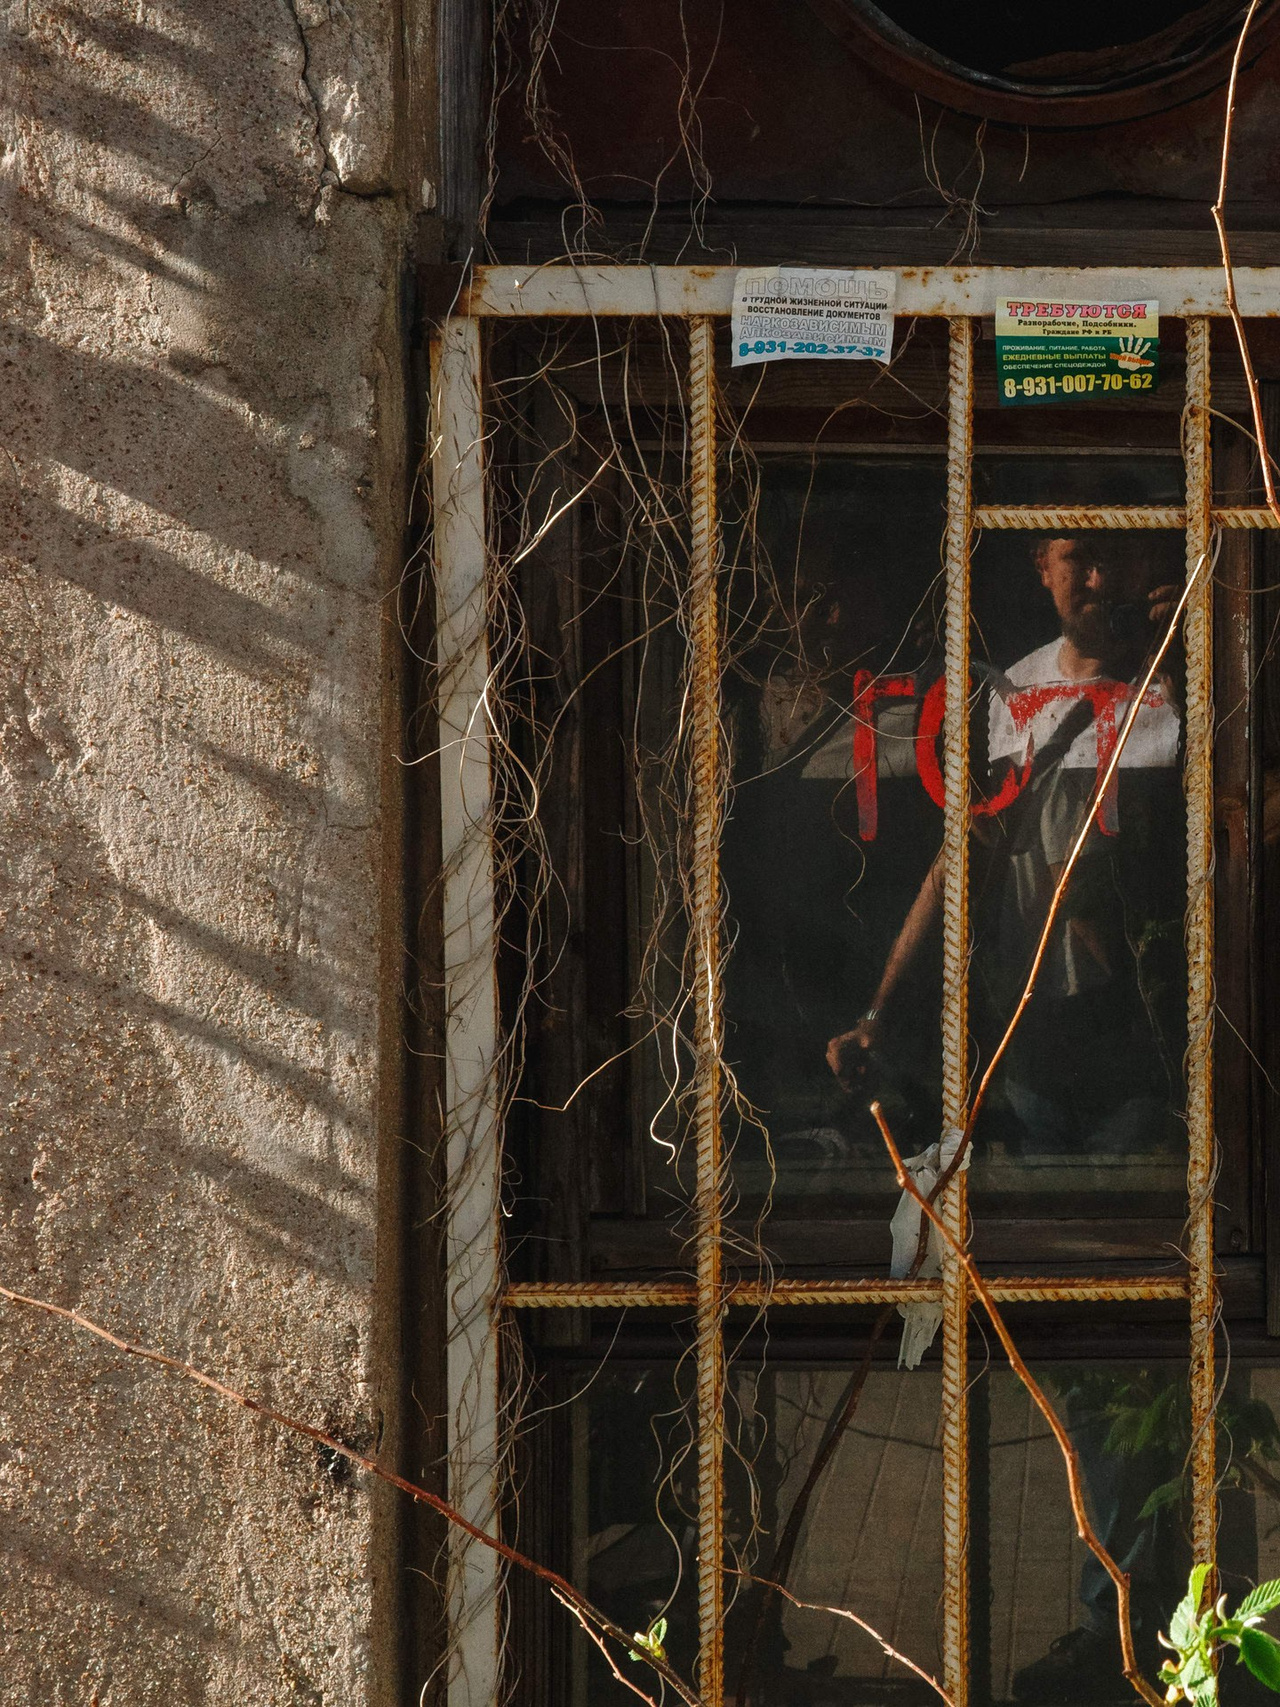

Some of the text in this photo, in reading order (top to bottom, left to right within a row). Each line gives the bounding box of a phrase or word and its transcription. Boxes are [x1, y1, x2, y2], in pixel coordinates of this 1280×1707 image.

[745, 277, 888, 302] ПОМОЩЬ
[750, 296, 787, 304] ТРУДНОЙ
[790, 297, 841, 308] ЖИЗНЕННОЙ
[844, 302, 887, 311] СИТУАЦИИ
[1007, 301, 1147, 319] ТРЕБУЮТСЯ
[748, 306, 881, 320] ВОССТАНОВЛЕНИЕ ДОКУМЕНТОВ
[740, 315, 887, 337] НАРКОЗАВИСИМЫМ
[1018, 319, 1137, 329] Разнорабочие, Подсобники.
[740, 327, 886, 347] АЛКОЗАВИСИМЫМ
[739, 341, 885, 357] 8-931-202-37-37
[1055, 361, 1106, 369] СПЕЦОДЕЖДОЙ
[1004, 373, 1153, 398] 8-931-007-70-62
